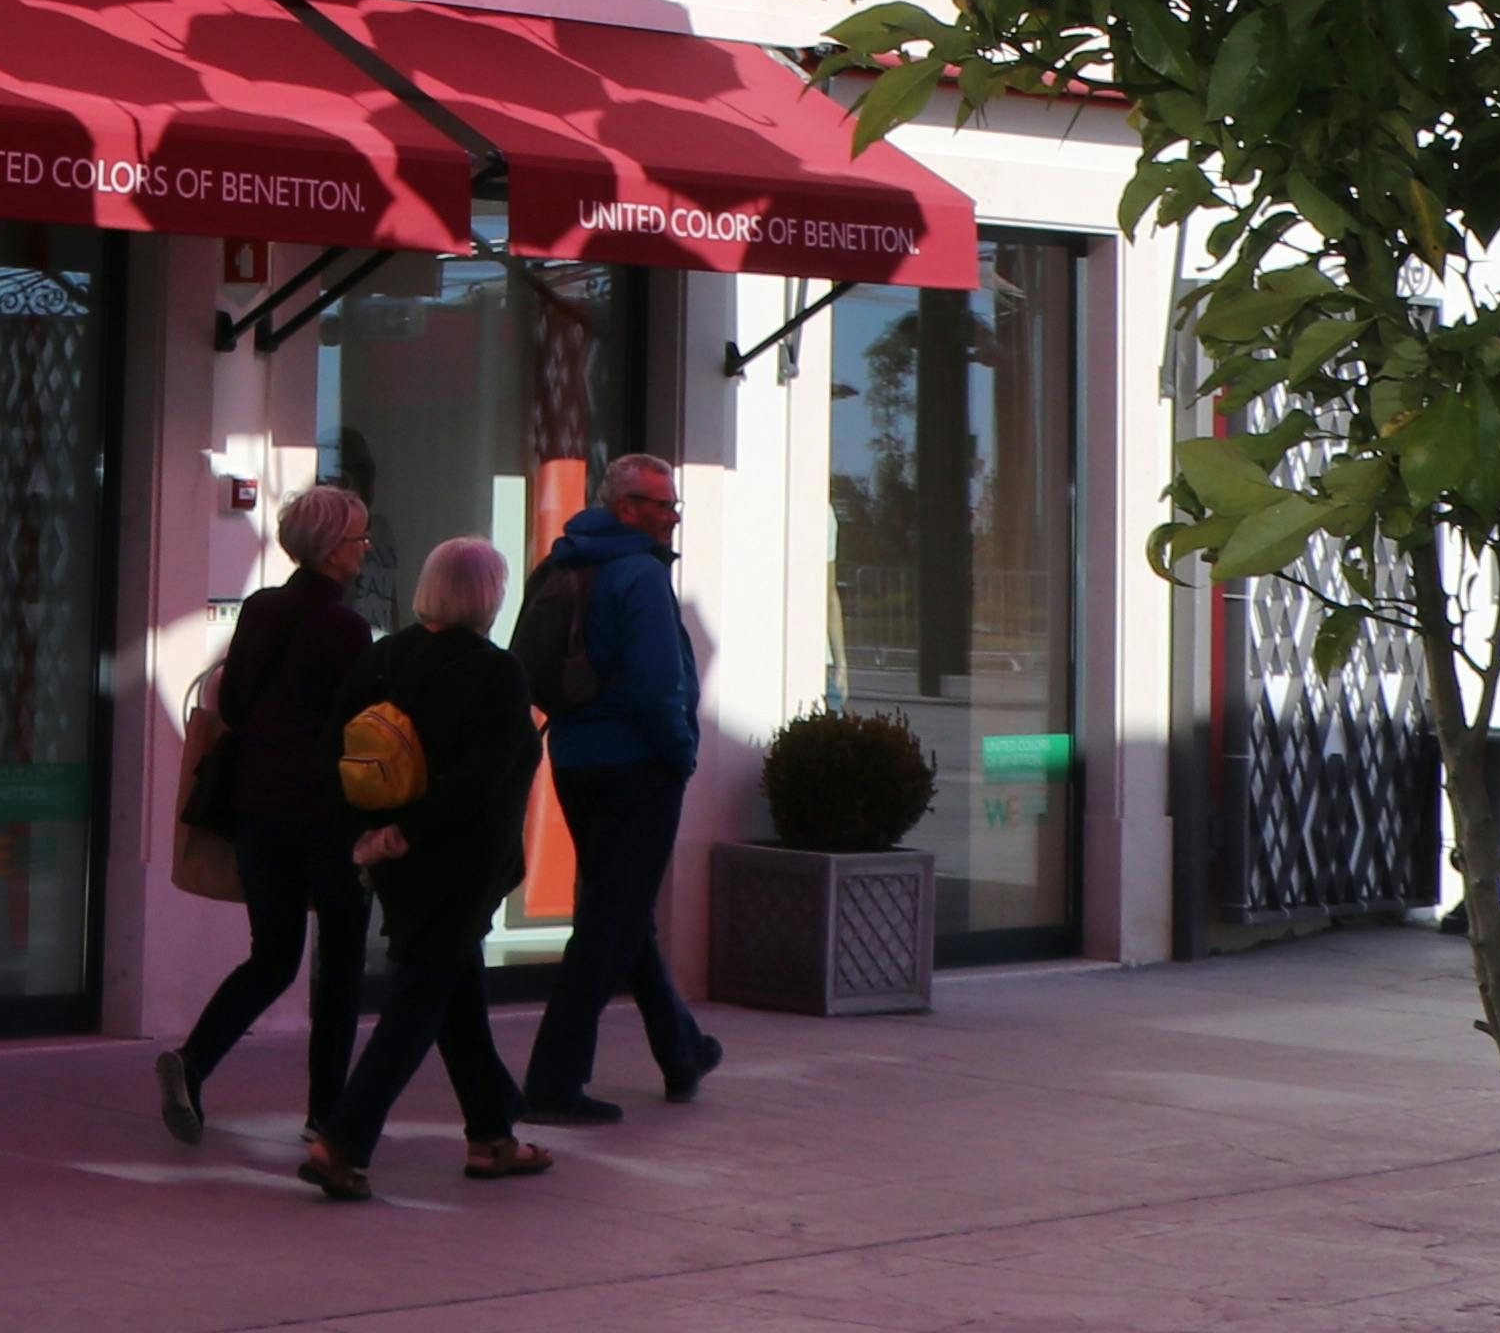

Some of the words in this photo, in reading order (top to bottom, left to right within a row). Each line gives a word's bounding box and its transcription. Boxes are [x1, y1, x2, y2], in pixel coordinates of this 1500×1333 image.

[52, 156, 168, 196] COLORS
[176, 167, 213, 200] OF
[222, 170, 366, 213] BENETTON.
[578, 198, 666, 235] UNITED
[670, 207, 764, 243] COLORS
[768, 216, 798, 246] OF
[804, 219, 921, 256] BENETTON.
